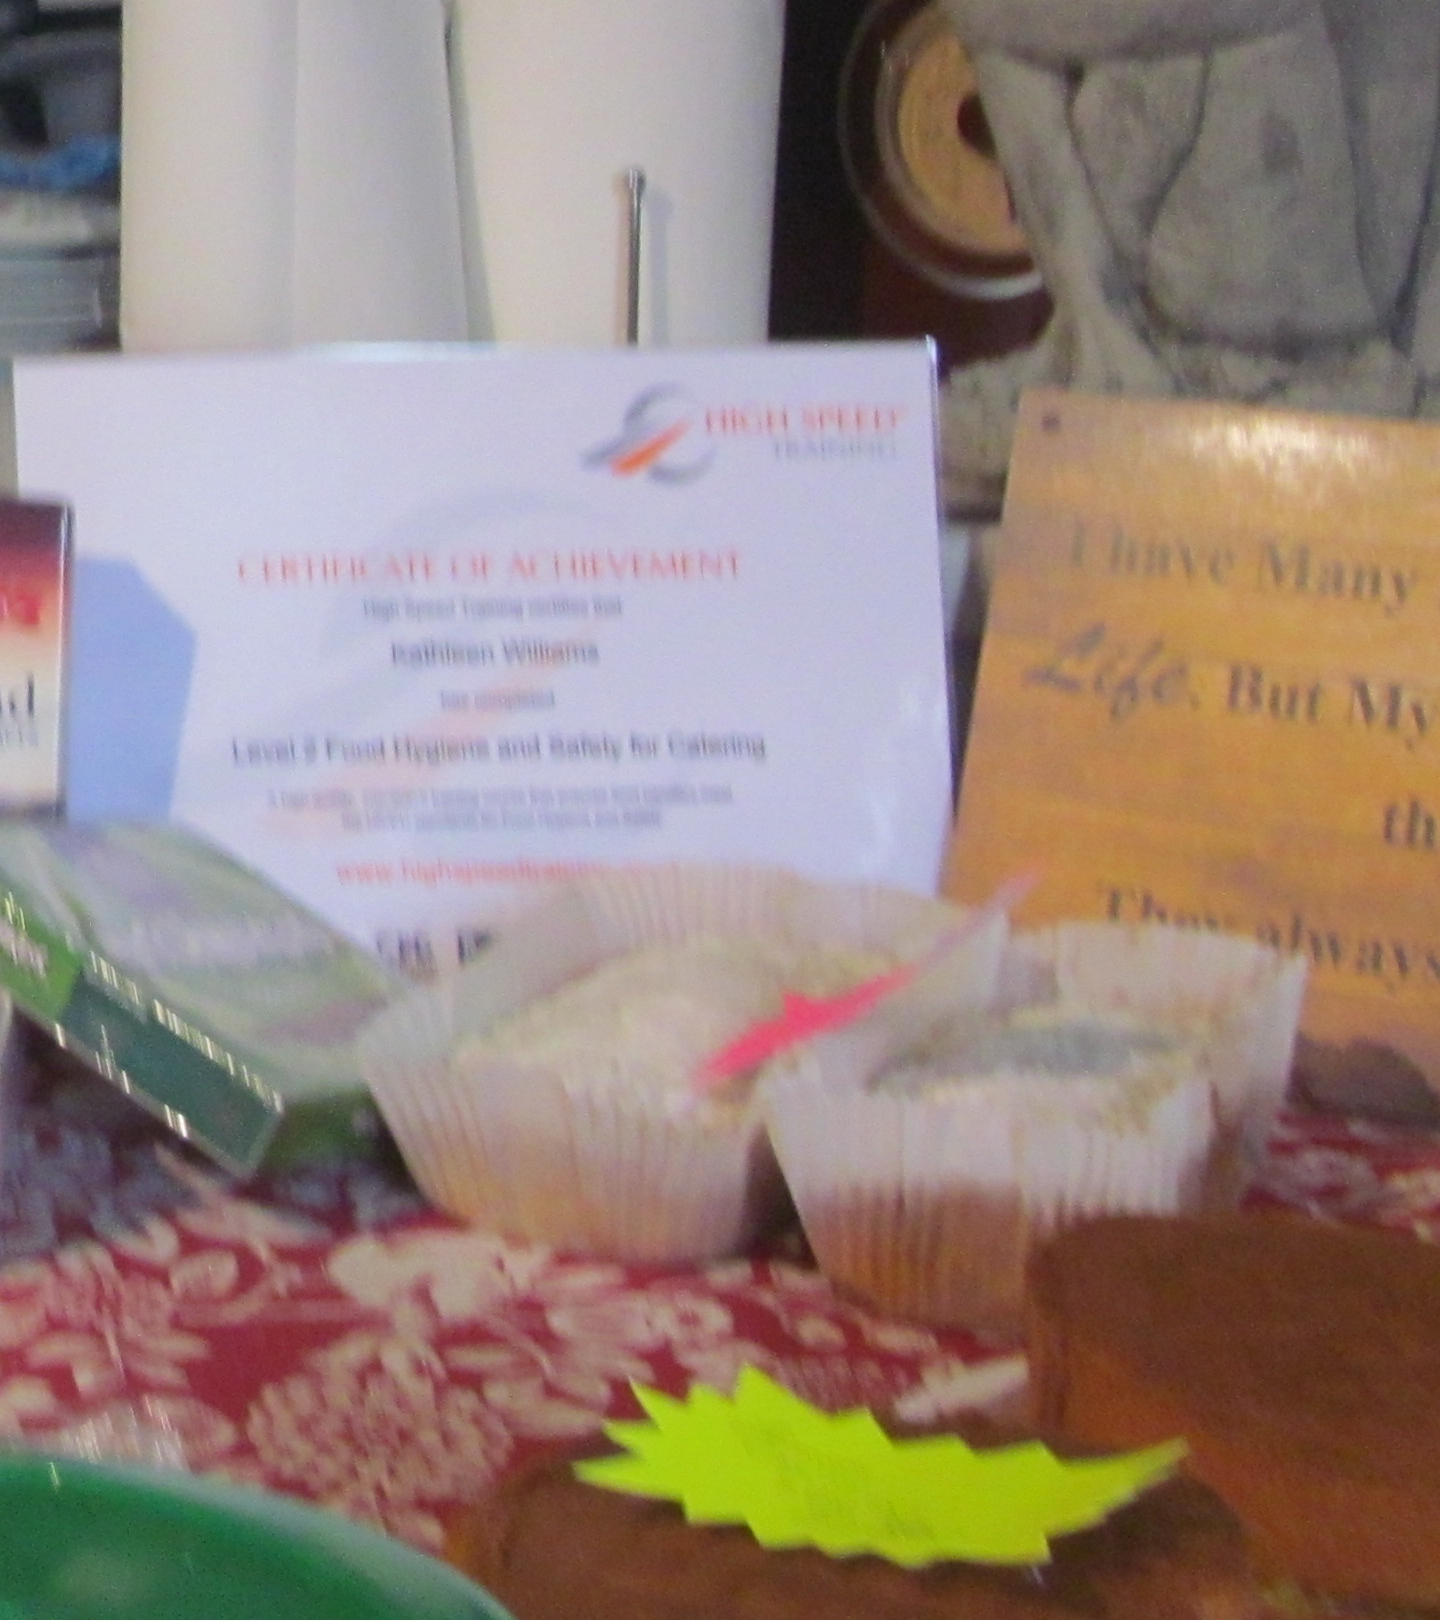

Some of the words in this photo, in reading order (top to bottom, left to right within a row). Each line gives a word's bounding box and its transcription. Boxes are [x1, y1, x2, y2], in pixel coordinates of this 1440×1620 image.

[703, 402, 788, 436] HIGH
[235, 550, 435, 584] CERTIFICATE
[448, 550, 492, 583] OF
[507, 547, 741, 582] ACHIEVEMENT
[1109, 526, 1236, 585] have
[1256, 536, 1416, 620] Many
[1226, 658, 1323, 725] But
[1348, 673, 1438, 753] My
